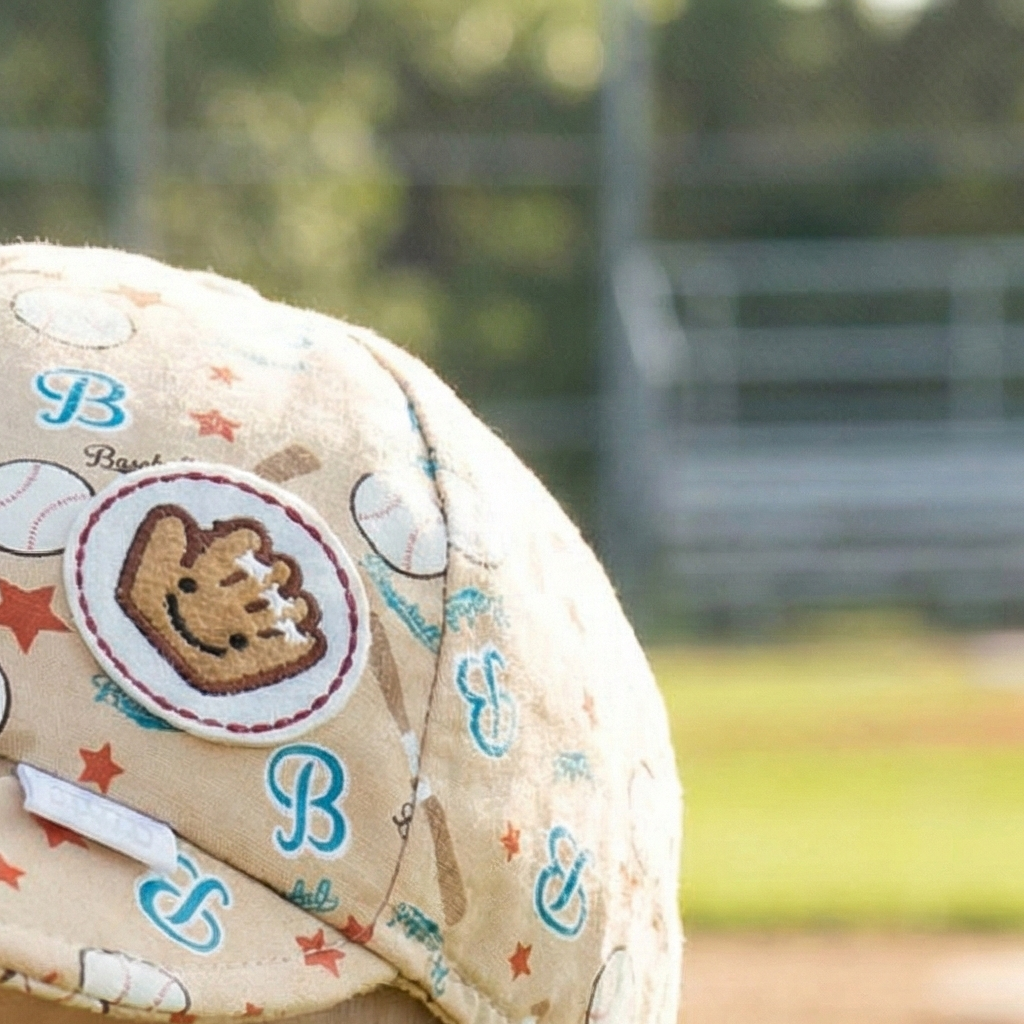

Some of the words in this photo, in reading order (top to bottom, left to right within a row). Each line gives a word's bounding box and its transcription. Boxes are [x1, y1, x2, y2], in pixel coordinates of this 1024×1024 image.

[34, 367, 126, 429] B
[267, 743, 348, 854] B
[137, 852, 227, 953] B
[534, 824, 595, 936] B
